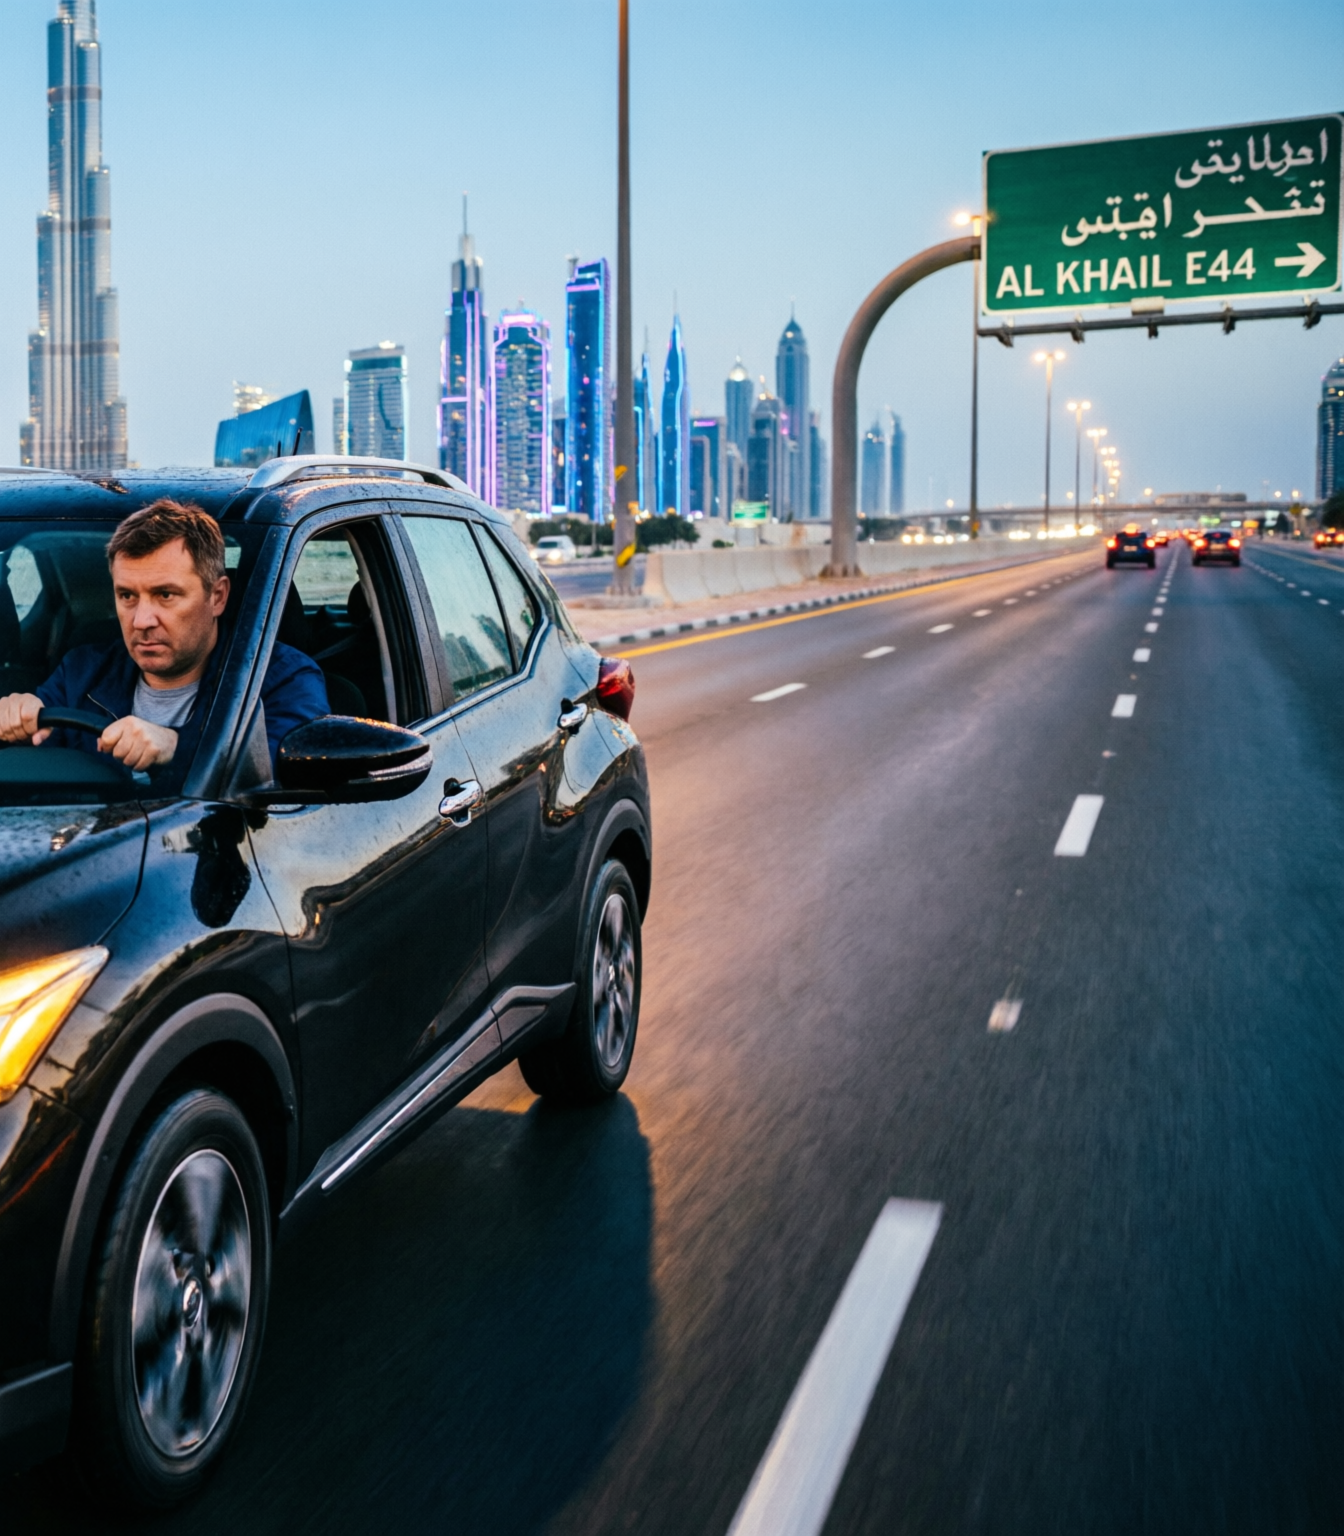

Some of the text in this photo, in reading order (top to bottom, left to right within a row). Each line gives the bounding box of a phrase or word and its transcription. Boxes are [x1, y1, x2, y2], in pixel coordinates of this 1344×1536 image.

[995, 247, 1256, 299] AL KHAIL E44
